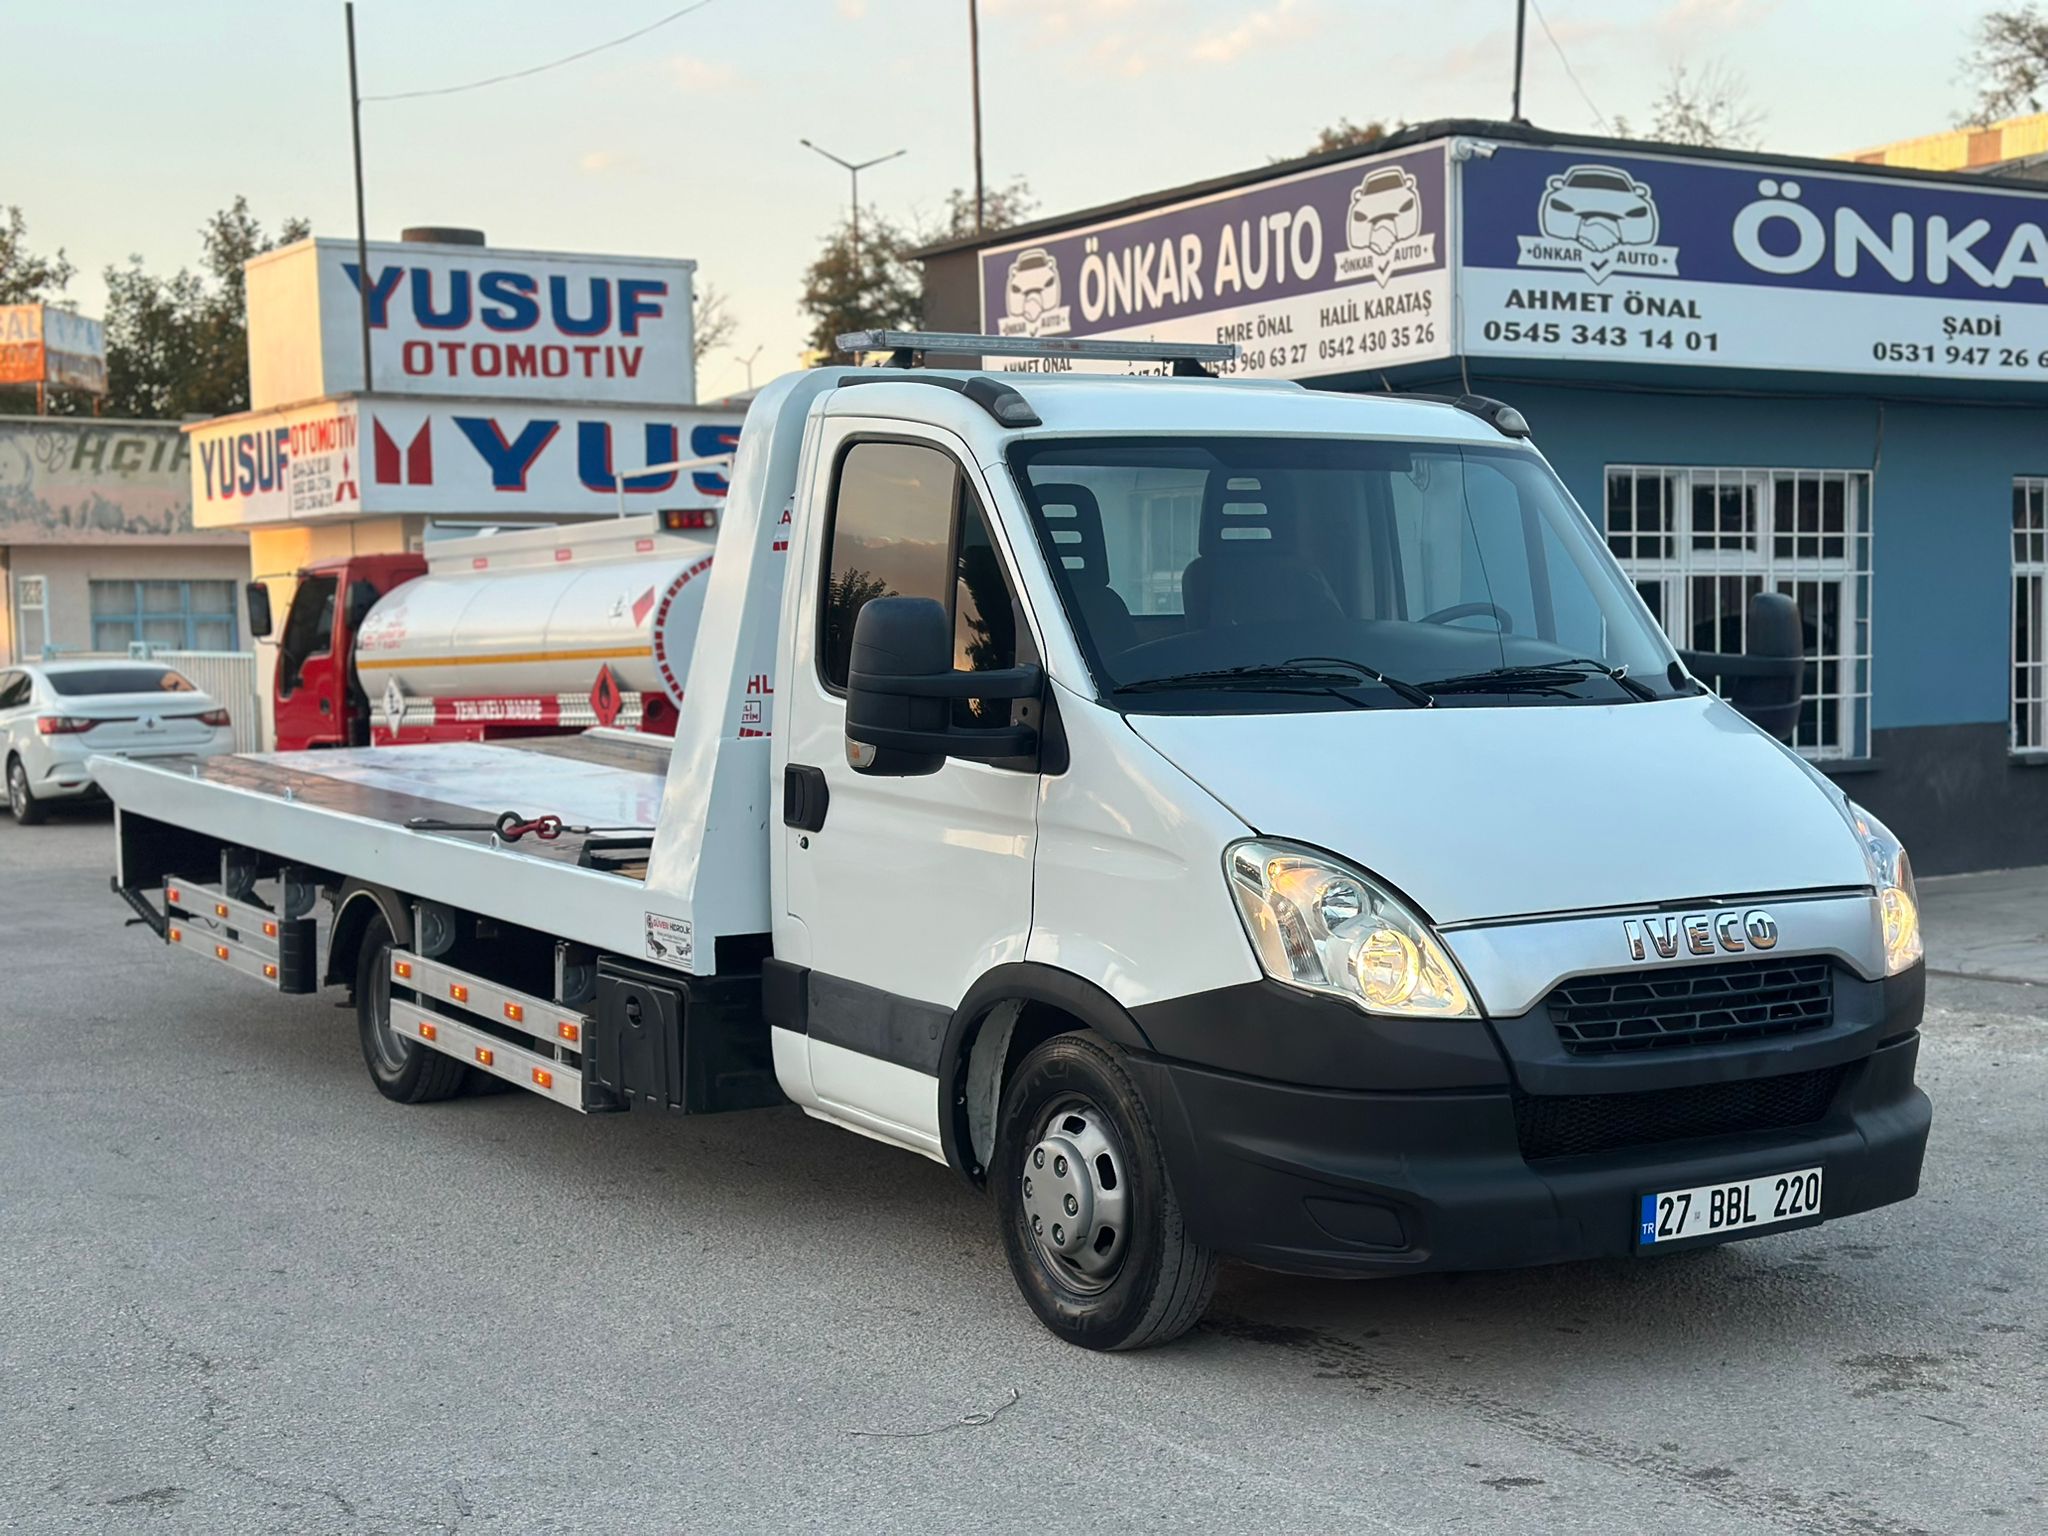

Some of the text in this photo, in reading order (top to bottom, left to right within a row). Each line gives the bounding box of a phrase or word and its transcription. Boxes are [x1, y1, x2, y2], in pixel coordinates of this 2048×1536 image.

[1733, 179, 2048, 289] ÖNKA
[1079, 205, 1322, 322] ÖNKAR AUTO
[1343, 244, 1422, 274] ÖNKAR AUTO
[1532, 244, 1659, 266] ÖNKAR AUTO
[341, 262, 668, 338] YUSUF
[1320, 289, 1432, 328] HALİL KARATAŞ
[1505, 289, 1702, 319] AHMET ÖNAL
[1217, 315, 1293, 344] EMRE ÖNAL
[1319, 322, 1435, 359] 0542 430 35 26
[1483, 321, 1718, 352] 0545 343 14 01
[1942, 314, 2001, 340] ŞADİ
[402, 340, 643, 378] OTOMOTIV
[1240, 351, 1266, 372] 960
[1270, 349, 1286, 367] 63
[1290, 344, 1307, 365] 27
[1873, 341, 1934, 363] 0531
[1945, 346, 1990, 366] 947
[1999, 349, 2029, 368] 26
[199, 427, 290, 501] YUSUF
[1623, 909, 1779, 961] IVECO
[1642, 1172, 1820, 1238] TR 27 BBL 220
